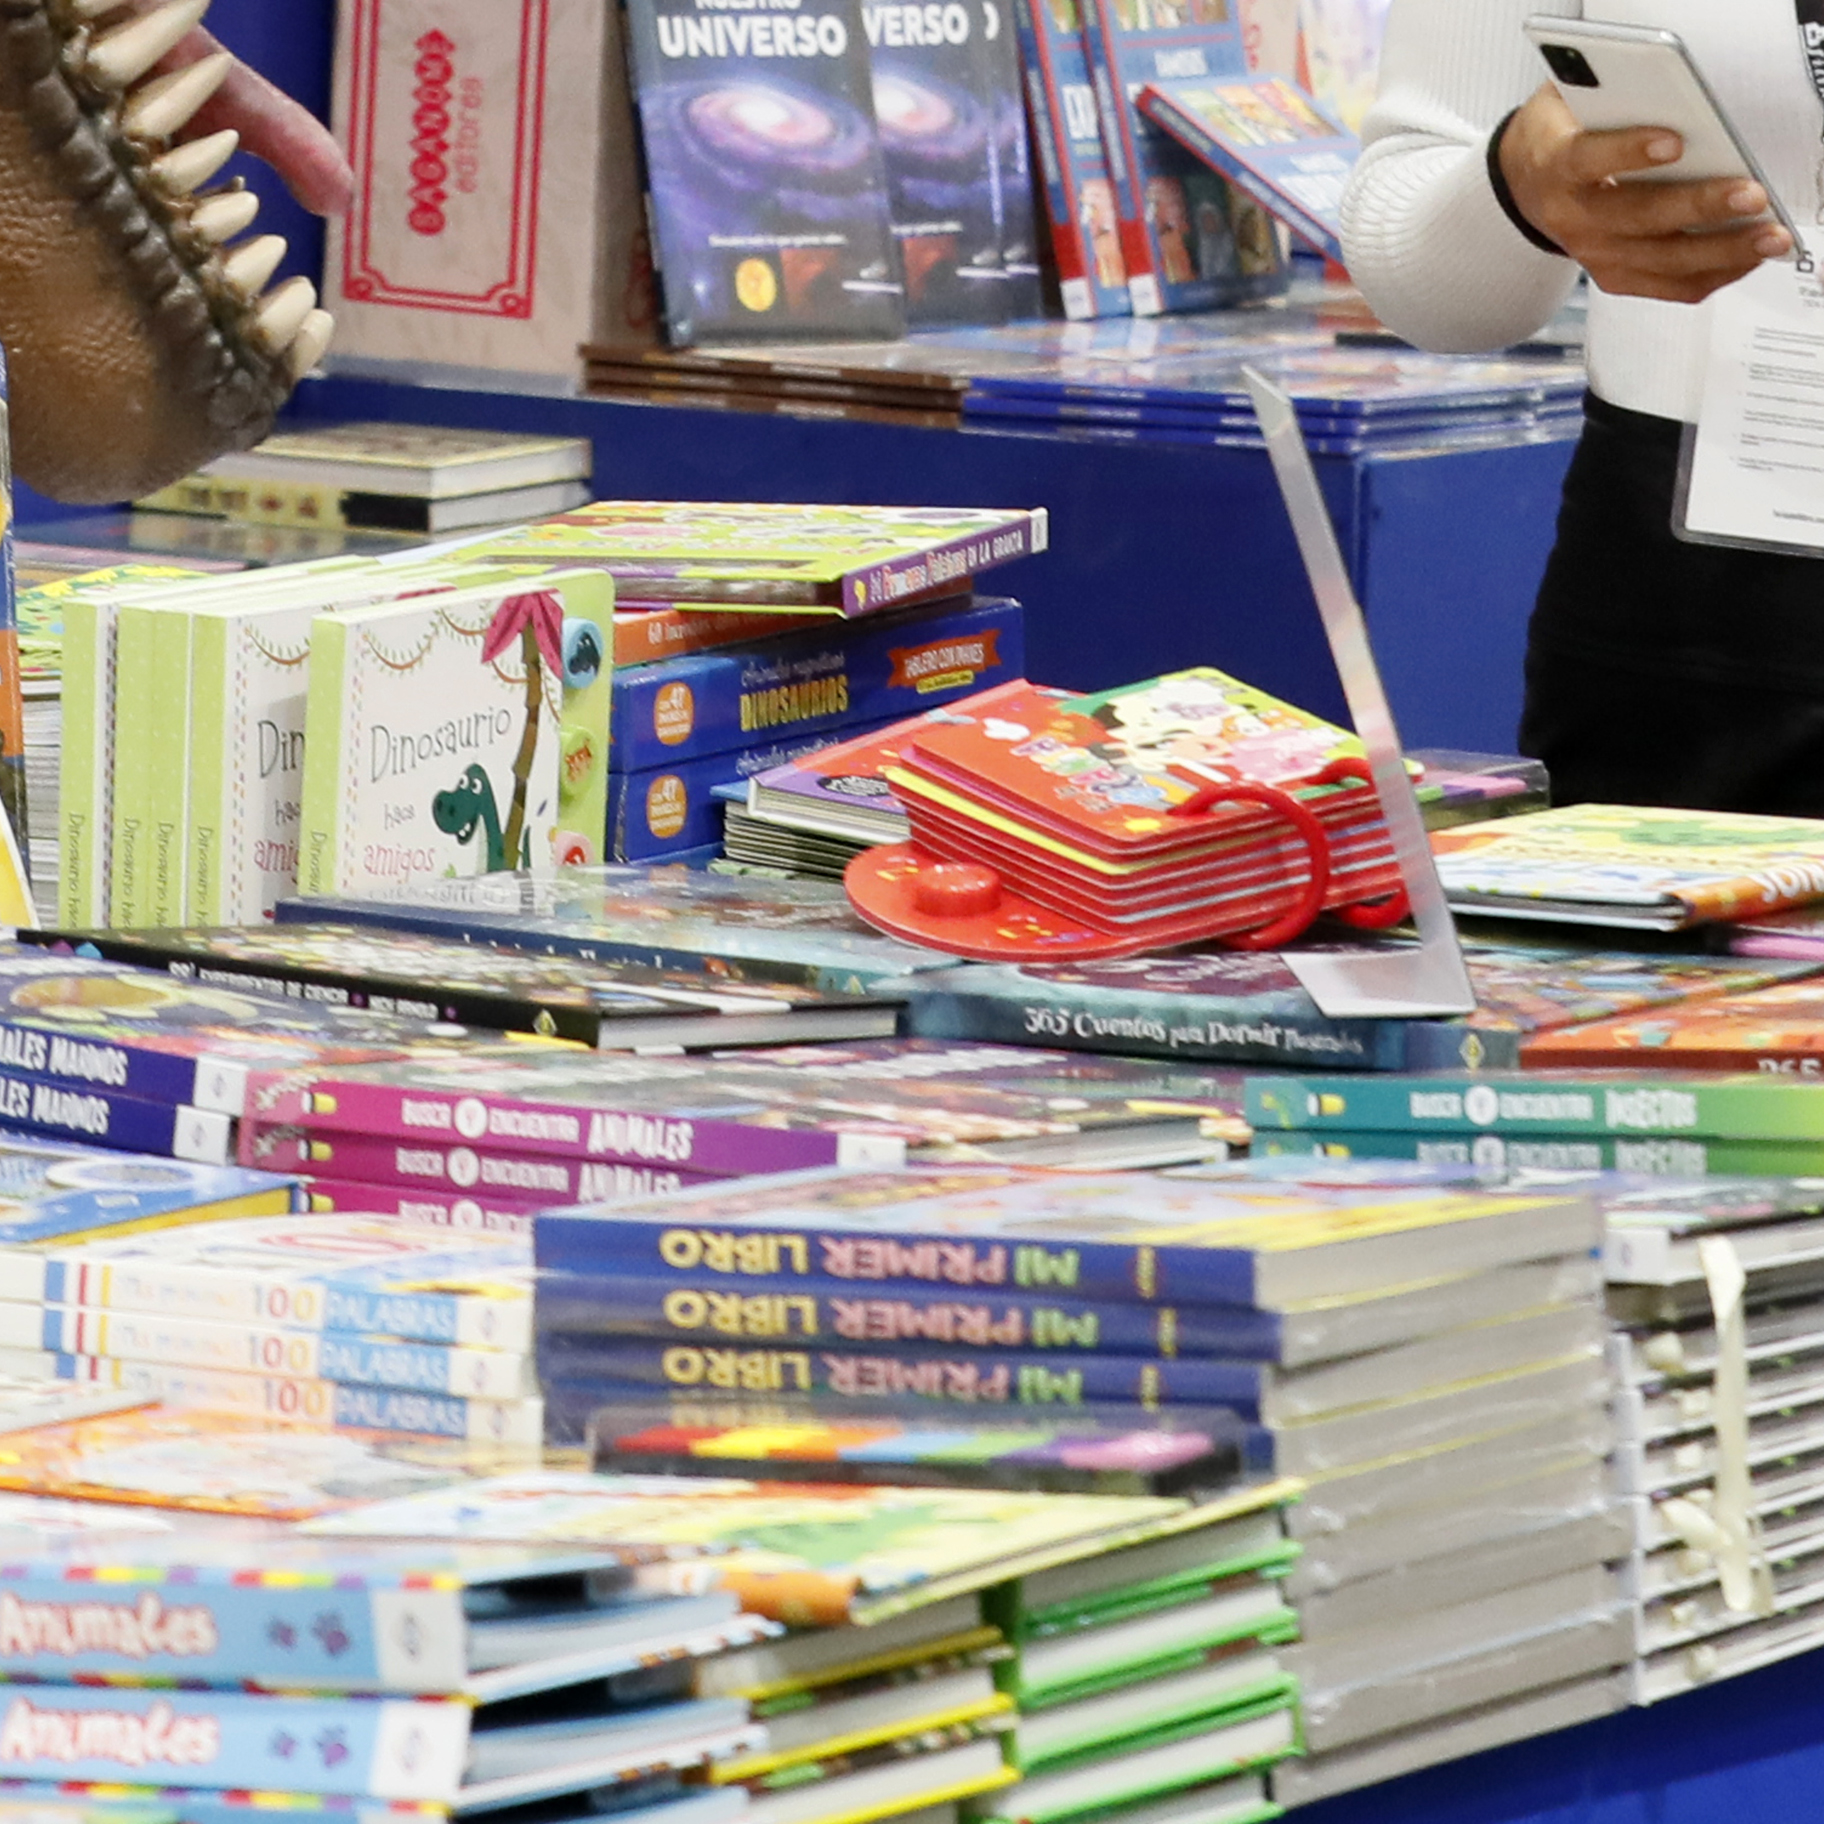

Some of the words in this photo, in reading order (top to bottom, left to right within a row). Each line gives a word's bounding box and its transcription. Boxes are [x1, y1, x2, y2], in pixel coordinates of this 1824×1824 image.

[656, 14, 849, 59] UNIVERSO
[863, 1, 970, 46] VERSO
[739, 674, 850, 733] DINOSAURIOS
[370, 706, 512, 784] Dinosaurio
[68, 811, 86, 889] Dinosaurio
[124, 815, 142, 893] Dinosaurio
[158, 819, 174, 901] Dinosaurio
[197, 824, 213, 907] Dinosaurio
[363, 842, 436, 874] amigos
[1024, 1006, 1070, 1036] 365
[1073, 1012, 1167, 1045] Cuentos
[1208, 1020, 1283, 1047] Dormir
[49, 1034, 128, 1087] MARINOS
[31, 1083, 110, 1136] MARINOS
[401, 1098, 452, 1130] BUSCA
[488, 1106, 580, 1144] ENCUENTRA
[586, 1111, 694, 1162] ANIMALES
[1409, 1091, 1463, 1120] BUSCA
[1499, 1092, 1595, 1121] ENCUENTRA
[1604, 1089, 1698, 1129] INSECTOS
[395, 1146, 445, 1177] BUSCA
[480, 1155, 570, 1194] ENCUENTRA
[1507, 1143, 1604, 1169] ENCUENTRA
[1616, 1139, 1708, 1175] INSECTOS
[657, 1228, 810, 1275] LIBRO
[818, 1233, 1010, 1286] PRIMER
[1013, 1243, 1081, 1288] MI
[254, 1282, 317, 1321] 100
[326, 1289, 458, 1340] PALABRAS
[663, 1287, 819, 1335] LIBRO
[829, 1295, 1027, 1347] PRIMER
[1031, 1306, 1100, 1350] MI
[248, 1334, 311, 1372] 100
[321, 1342, 451, 1392] PALABRAS
[660, 1345, 812, 1392] LIBRO
[820, 1351, 1010, 1404] PRIMER
[1017, 1363, 1085, 1406] MI
[263, 1379, 326, 1416] 100
[336, 1387, 464, 1434] PALABRAS
